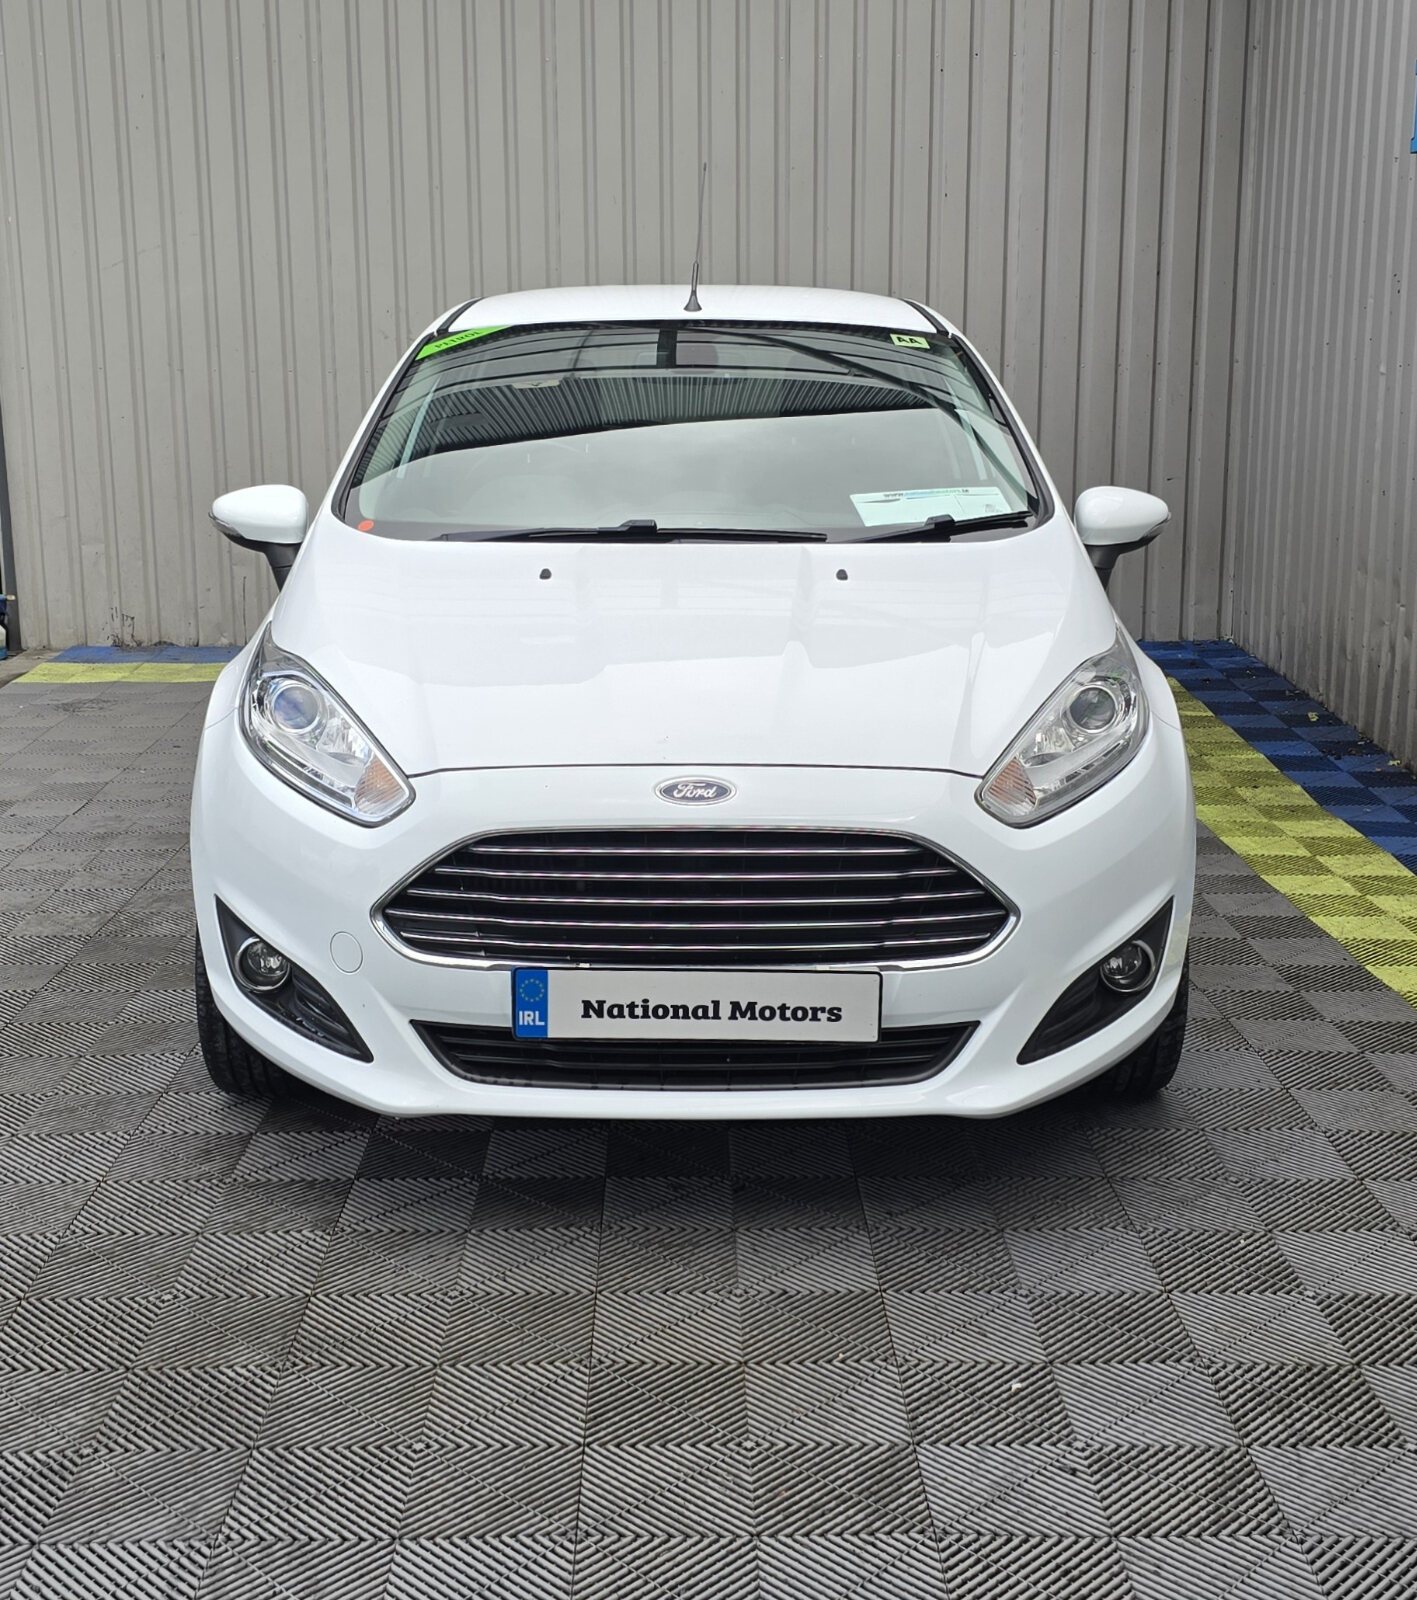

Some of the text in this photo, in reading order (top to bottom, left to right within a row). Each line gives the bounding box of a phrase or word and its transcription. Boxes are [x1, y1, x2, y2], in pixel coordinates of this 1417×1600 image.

[434, 330, 482, 349] PETROL
[896, 336, 922, 345] AA
[673, 782, 717, 799] Ford
[518, 1010, 545, 1026] IRL
[580, 998, 842, 1022] National Motors
